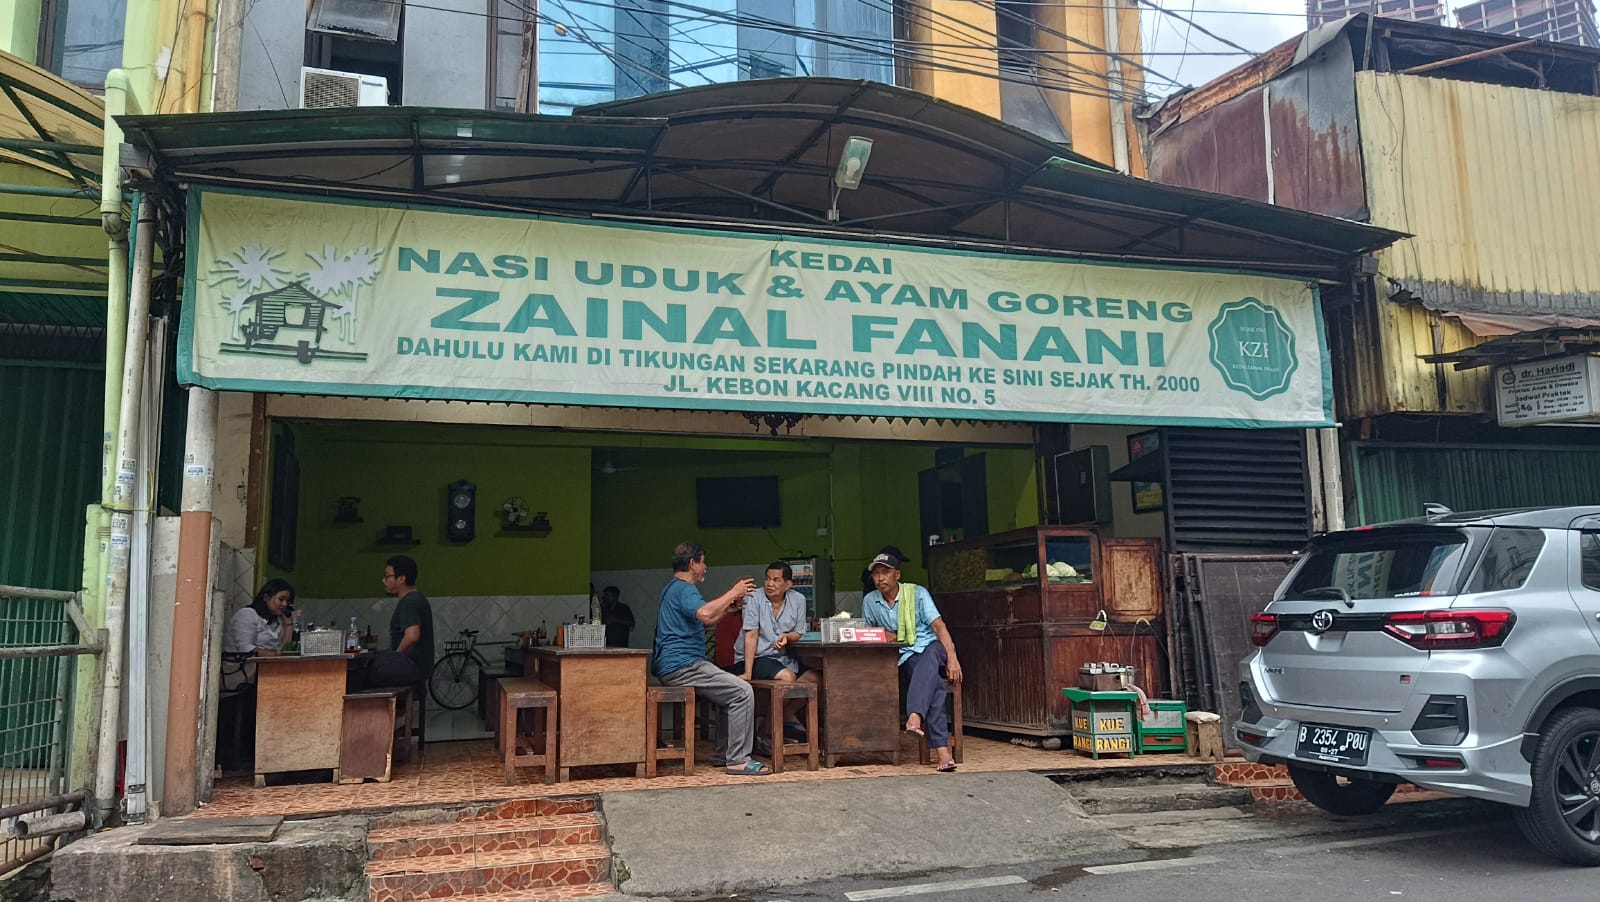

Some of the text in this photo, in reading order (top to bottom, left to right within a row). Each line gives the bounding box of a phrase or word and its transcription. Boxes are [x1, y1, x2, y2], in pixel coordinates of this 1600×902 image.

[770, 249, 893, 275] KEDAI
[398, 246, 1193, 323] NASI UDUK & AYAM GORENG
[430, 286, 1166, 368] ZAINAL FANANI
[1239, 341, 1270, 358] KZF
[396, 336, 1200, 393] DAHULU KAMI DI TIKUNGAN SEKARANG PINDAH KE SINI SEJAK TH. 2000
[1521, 369, 1534, 378] dr.
[1536, 362, 1575, 376] Hariadi
[663, 374, 996, 405] JL. KEBON KACANG VIII NO. 5
[1074, 717, 1088, 729] KUE
[1100, 718, 1124, 731] KUE
[1073, 735, 1092, 751] RANGI
[1096, 737, 1131, 751] RANGI
[1300, 726, 1308, 743] B
[1312, 728, 1339, 746] 2354
